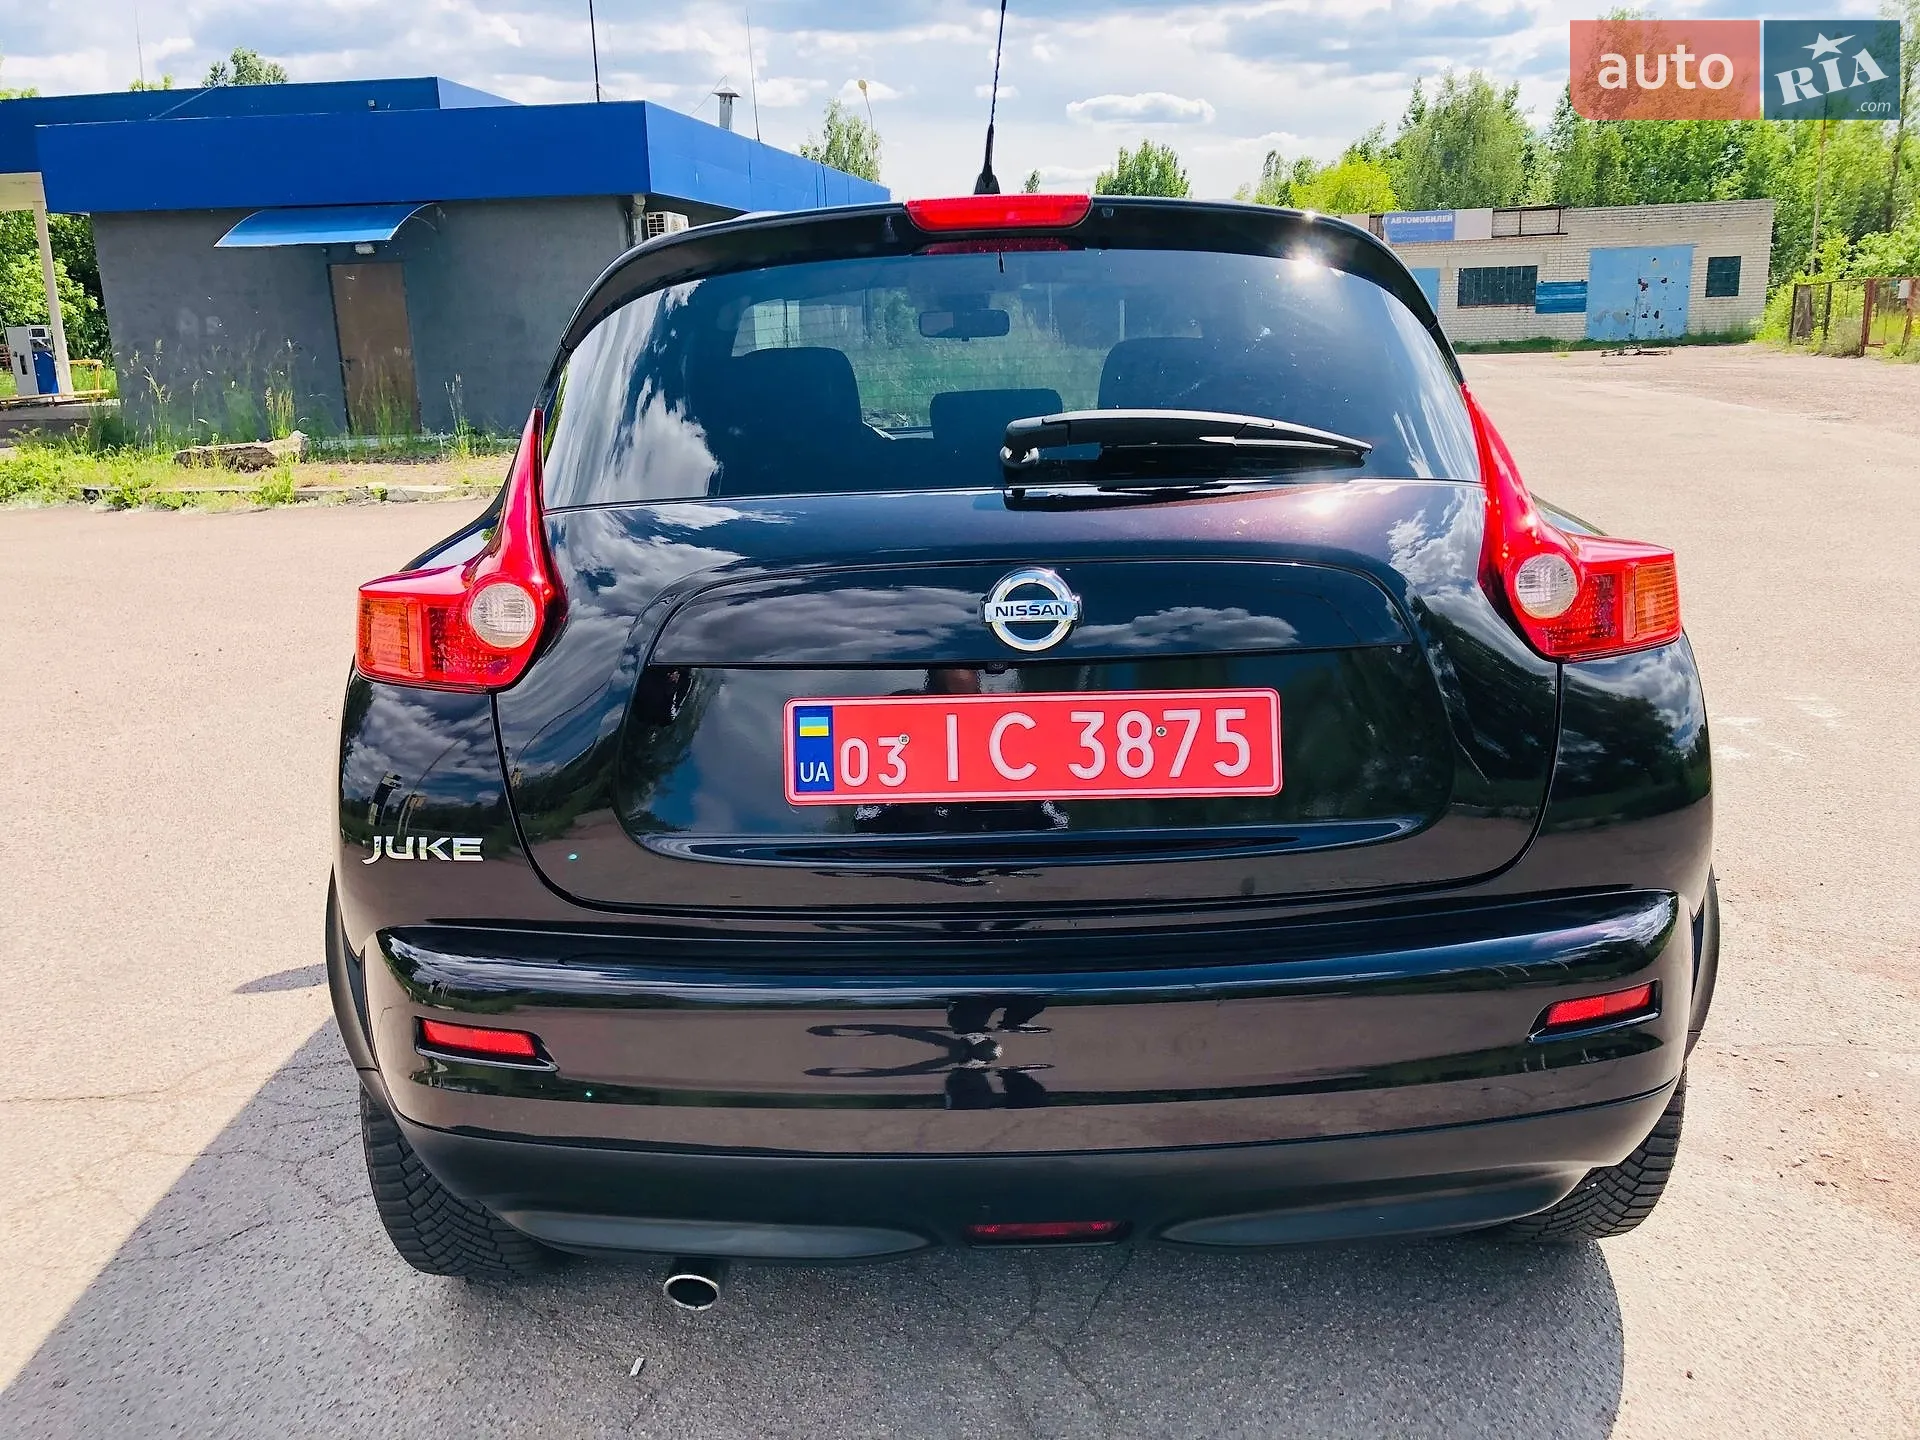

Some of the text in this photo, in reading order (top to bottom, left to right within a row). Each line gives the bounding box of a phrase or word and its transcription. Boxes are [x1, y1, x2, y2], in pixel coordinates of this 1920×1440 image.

[995, 604, 1068, 617] NISSAN
[840, 736, 908, 787] 03
[1068, 708, 1251, 780] 3875
[800, 761, 830, 783] UA
[361, 835, 484, 865] JUKE
